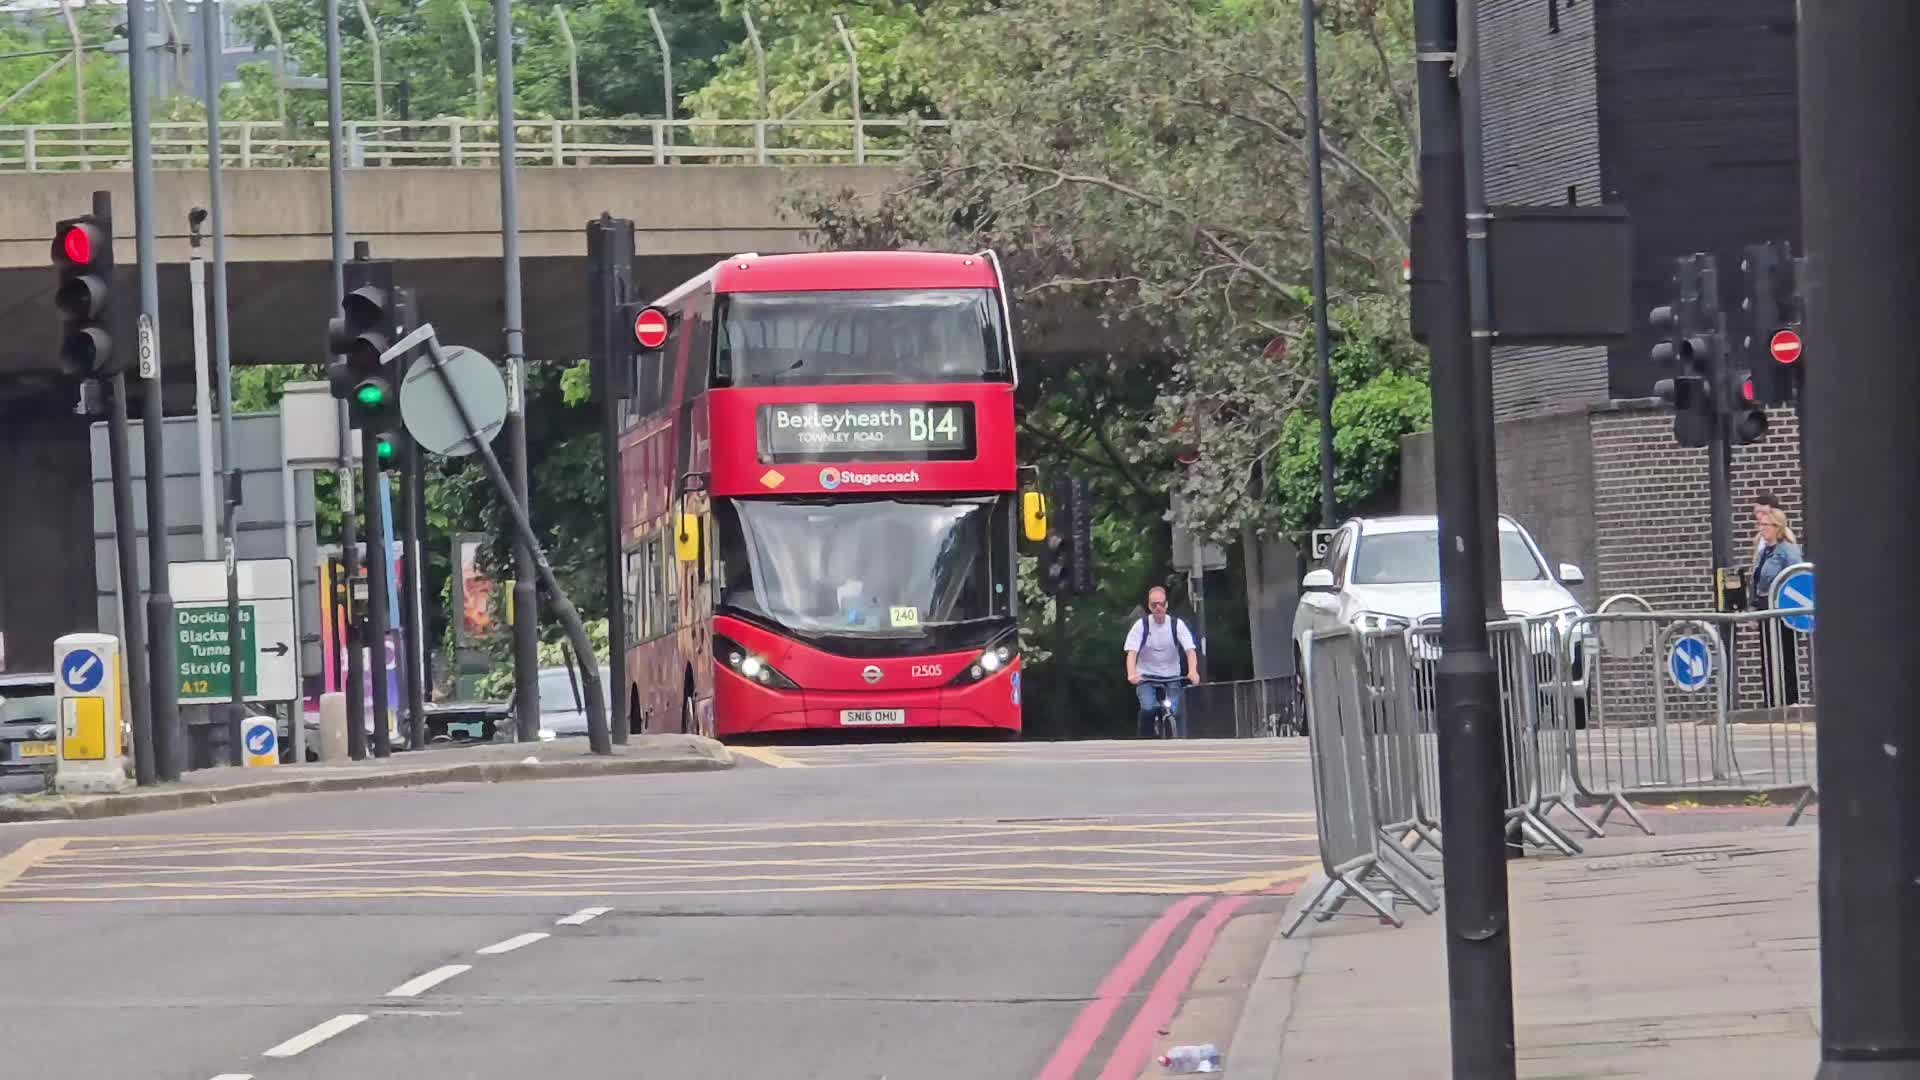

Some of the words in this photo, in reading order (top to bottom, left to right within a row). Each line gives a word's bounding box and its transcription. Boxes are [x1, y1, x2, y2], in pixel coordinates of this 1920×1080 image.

[777, 409, 902, 431] Bexleyheath
[909, 407, 958, 442] B14
[798, 432, 849, 443] TOWNLEY
[854, 431, 884, 442] ROAD
[841, 470, 920, 486] Stagecoach
[894, 609, 914, 622] 240
[180, 628, 246, 643] Blackwl
[190, 645, 231, 656] Tunne
[912, 664, 943, 677] 12505
[181, 680, 208, 693] A12
[847, 711, 872, 722] SN16
